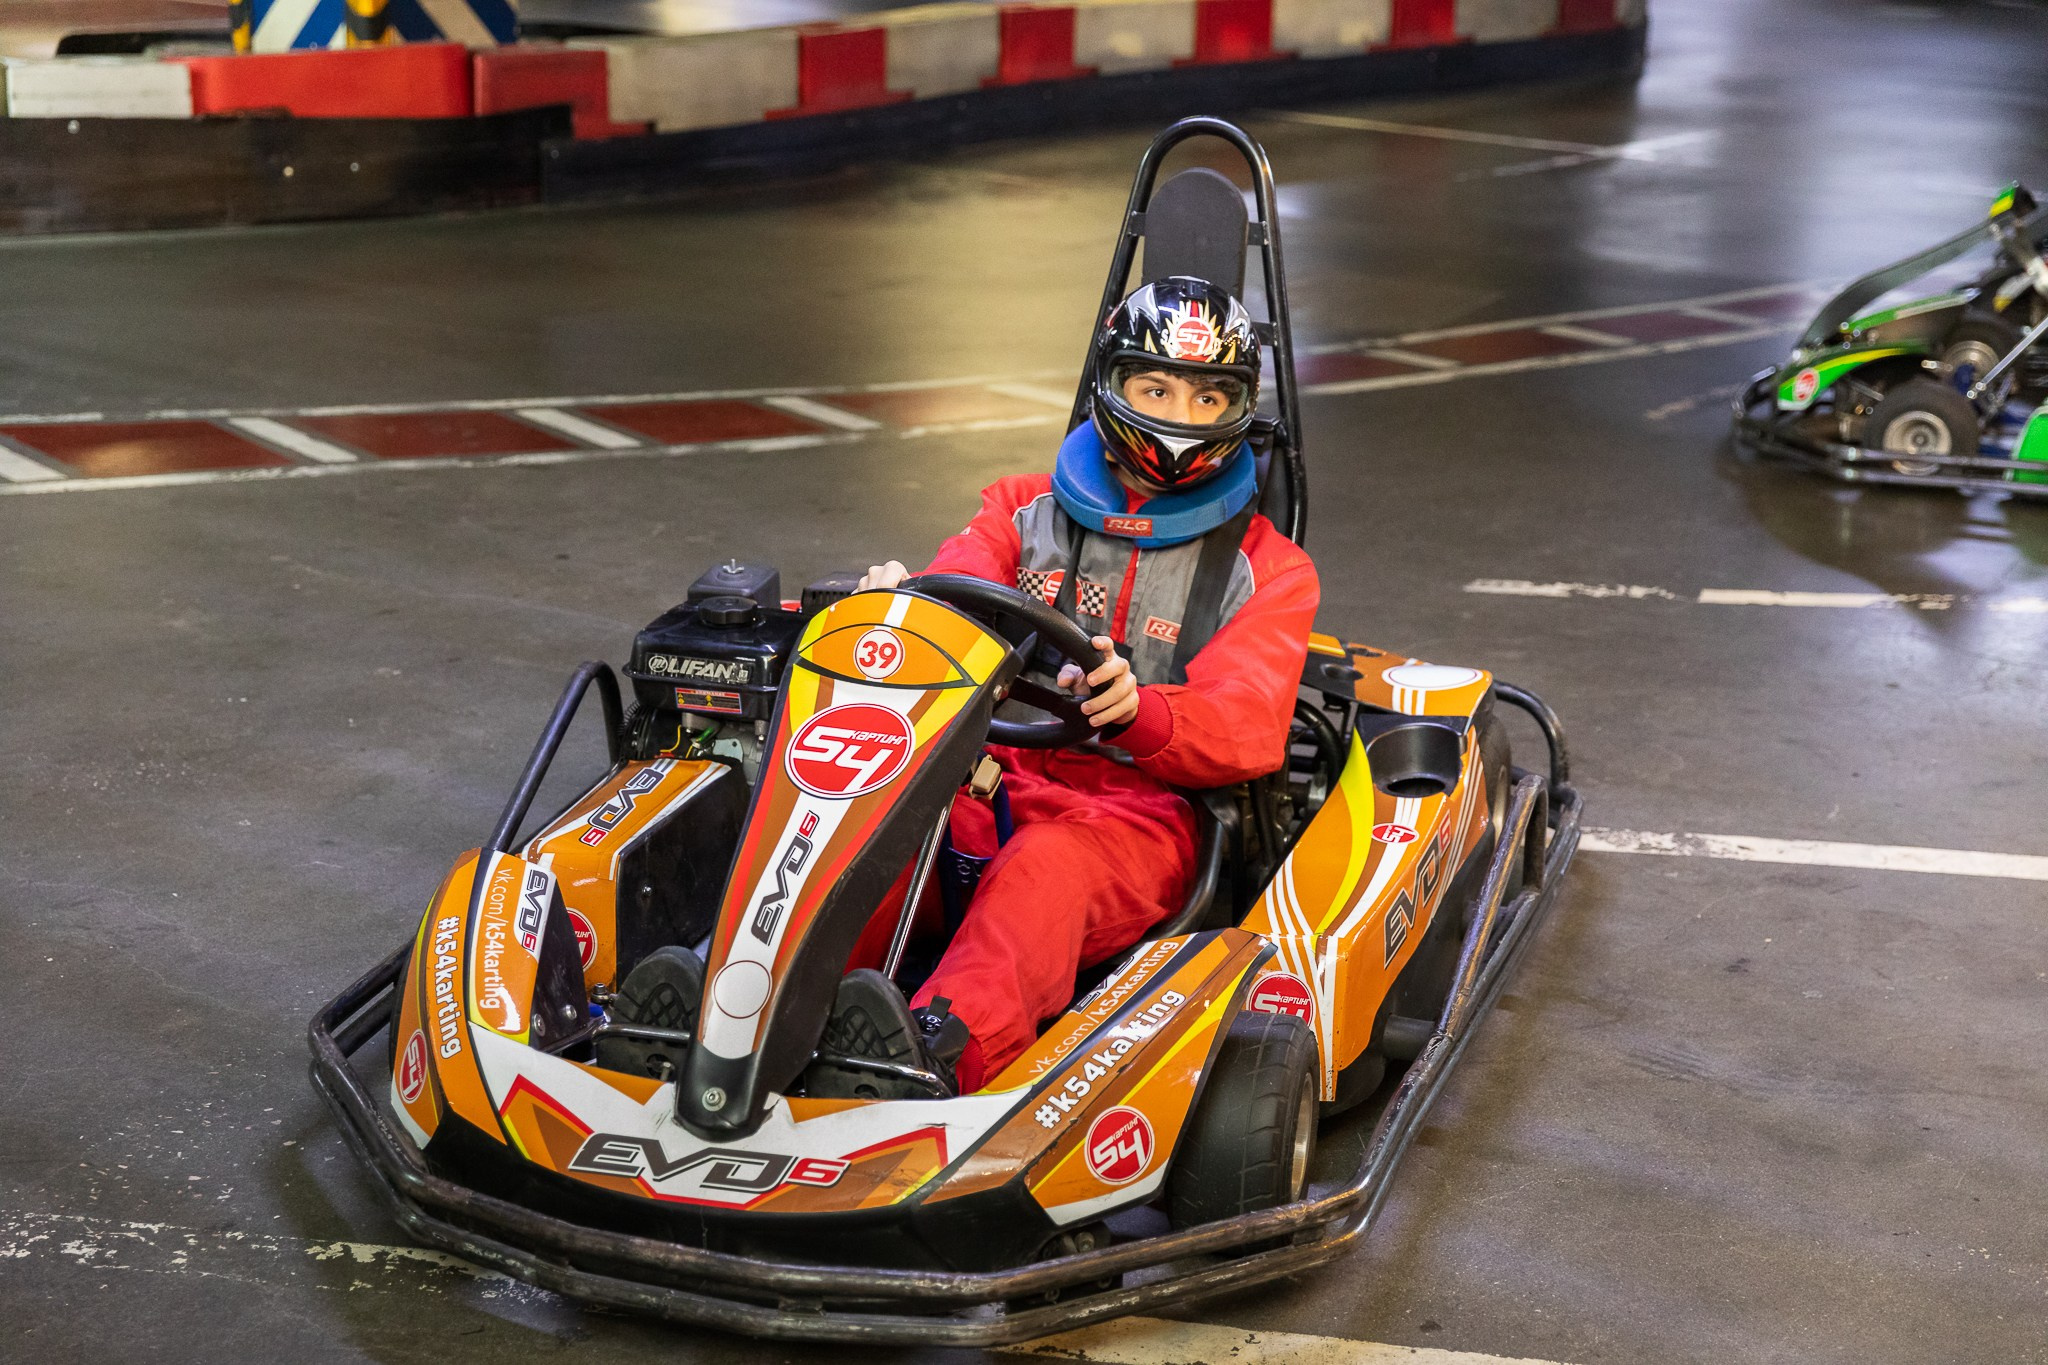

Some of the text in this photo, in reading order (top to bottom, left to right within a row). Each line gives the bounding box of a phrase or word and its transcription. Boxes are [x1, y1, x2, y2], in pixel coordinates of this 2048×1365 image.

[1106, 519, 1150, 531] RLG
[667, 658, 733, 679] LIFAN
[858, 640, 898, 669] 39
[793, 725, 894, 792] 54
[480, 867, 515, 1011] vk.com/k54karting
[434, 915, 463, 1060] #k54karting
[1028, 940, 1180, 1075] vk.com/k54karting
[1092, 1128, 1146, 1176] 54
